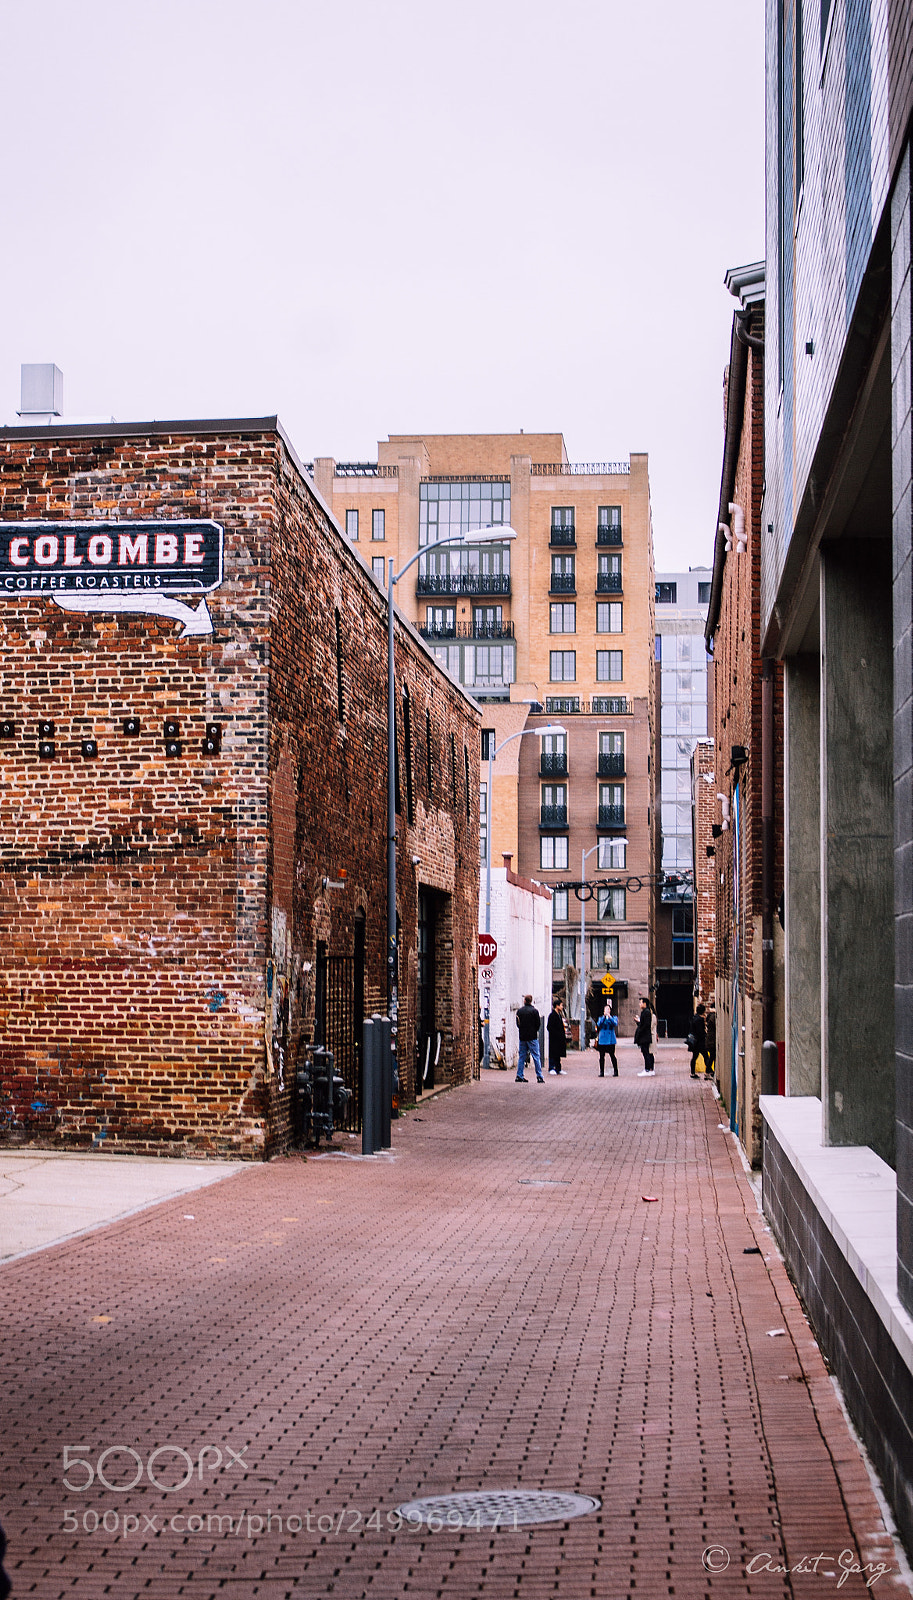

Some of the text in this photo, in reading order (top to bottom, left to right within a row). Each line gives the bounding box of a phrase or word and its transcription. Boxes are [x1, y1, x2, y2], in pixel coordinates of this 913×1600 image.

[9, 533, 205, 566] COLOMBE
[5, 575, 161, 588] COFFEE ROASTERS
[479, 943, 496, 956] TOP
